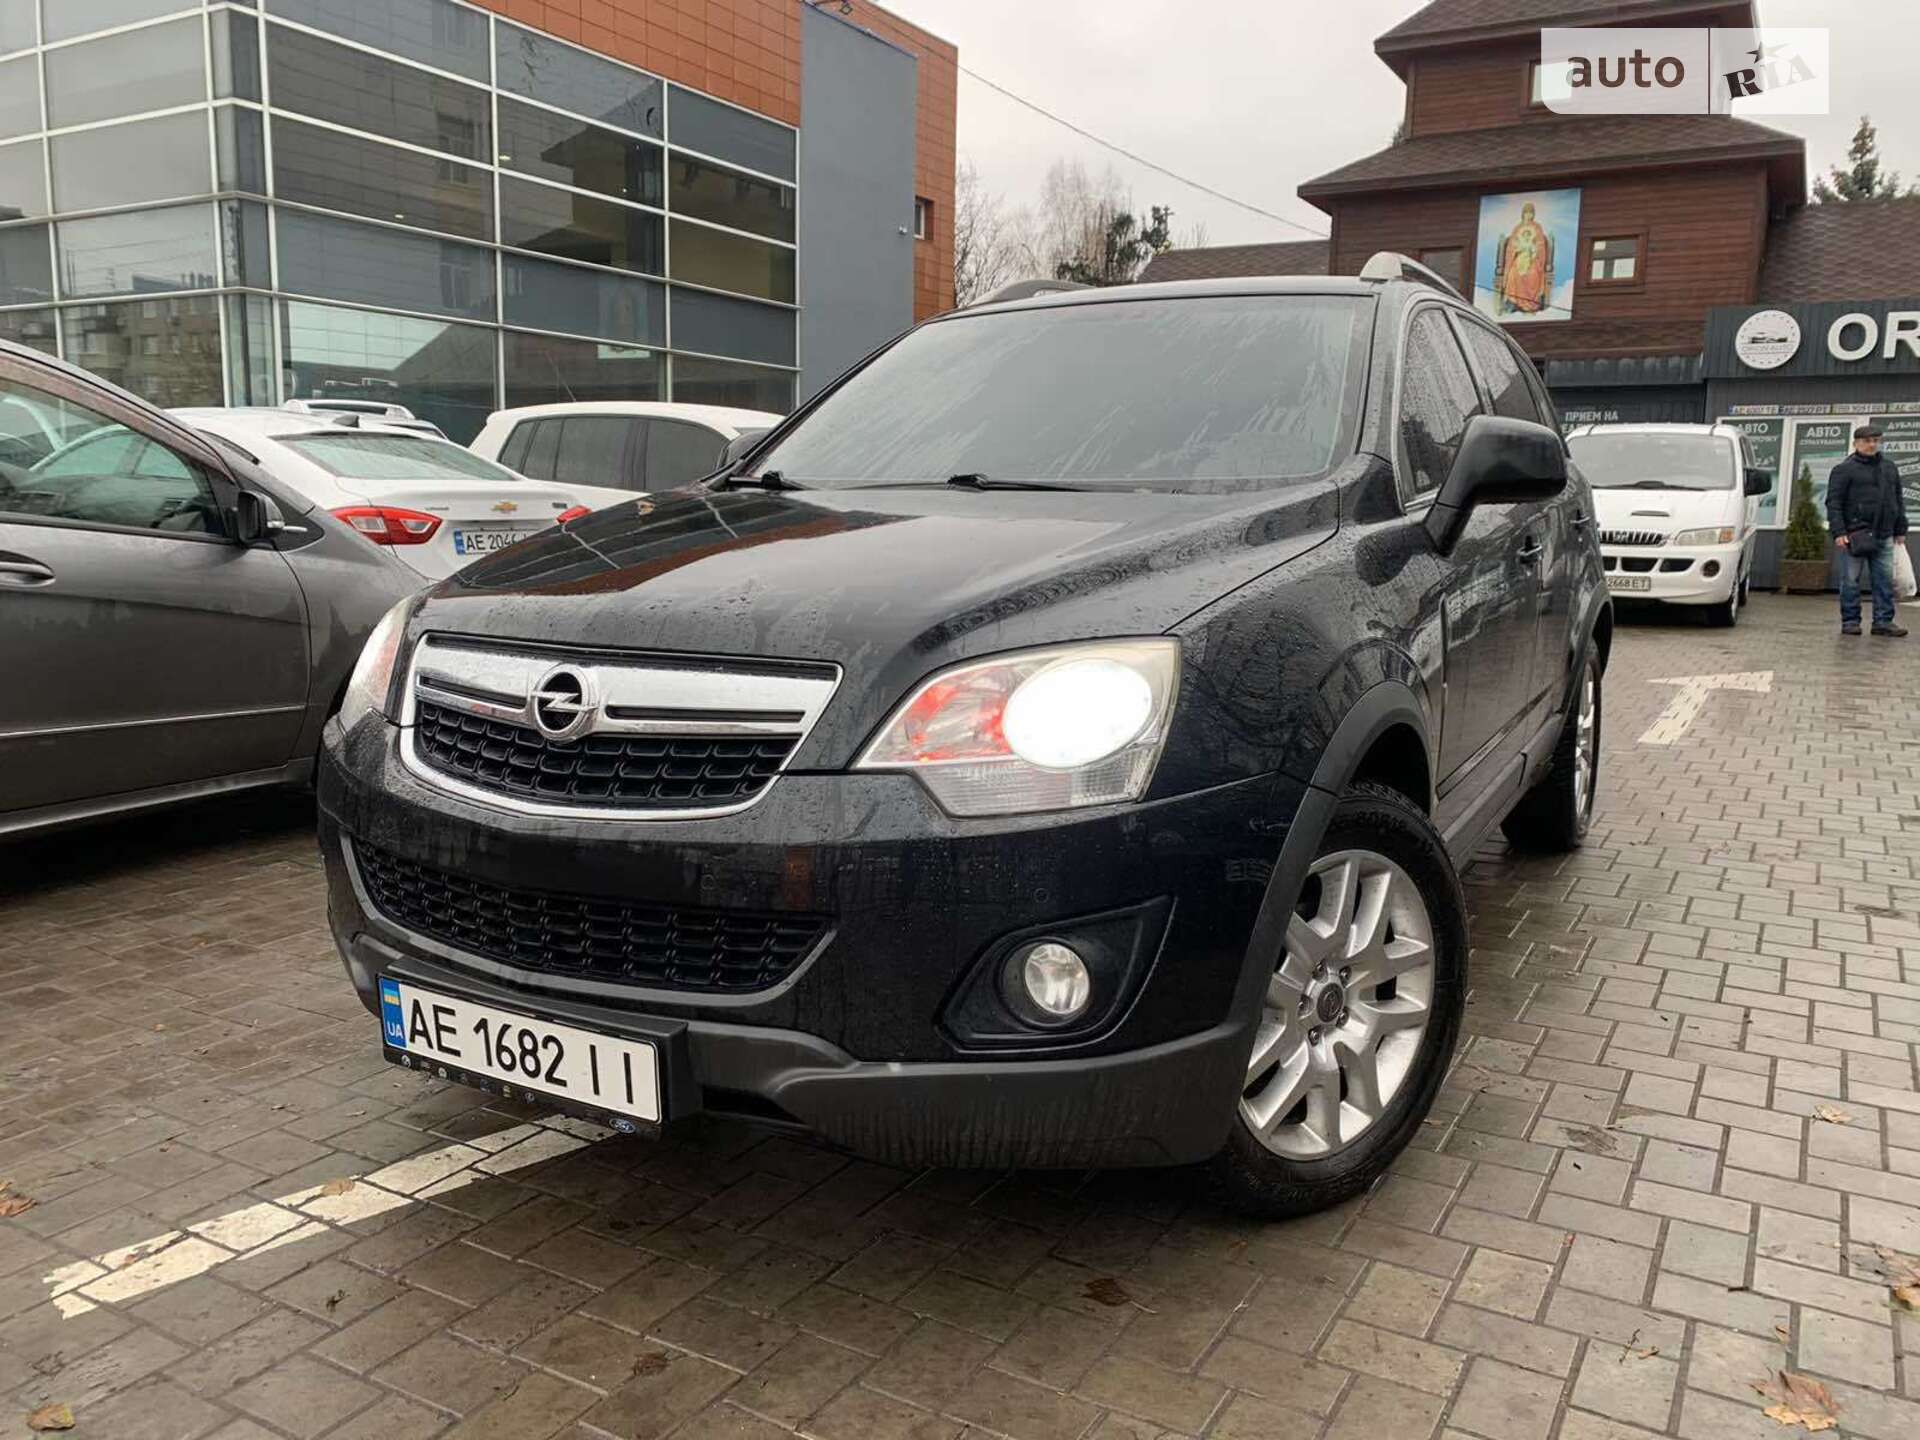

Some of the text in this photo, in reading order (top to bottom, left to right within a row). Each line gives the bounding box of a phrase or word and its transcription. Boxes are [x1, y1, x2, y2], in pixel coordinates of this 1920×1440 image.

[1827, 311, 1920, 361] OR
[1806, 426, 1841, 438] АВТО
[465, 534, 486, 551] AE
[387, 1020, 404, 1040] UA
[408, 998, 462, 1058] AE
[472, 1017, 568, 1088] 1682
